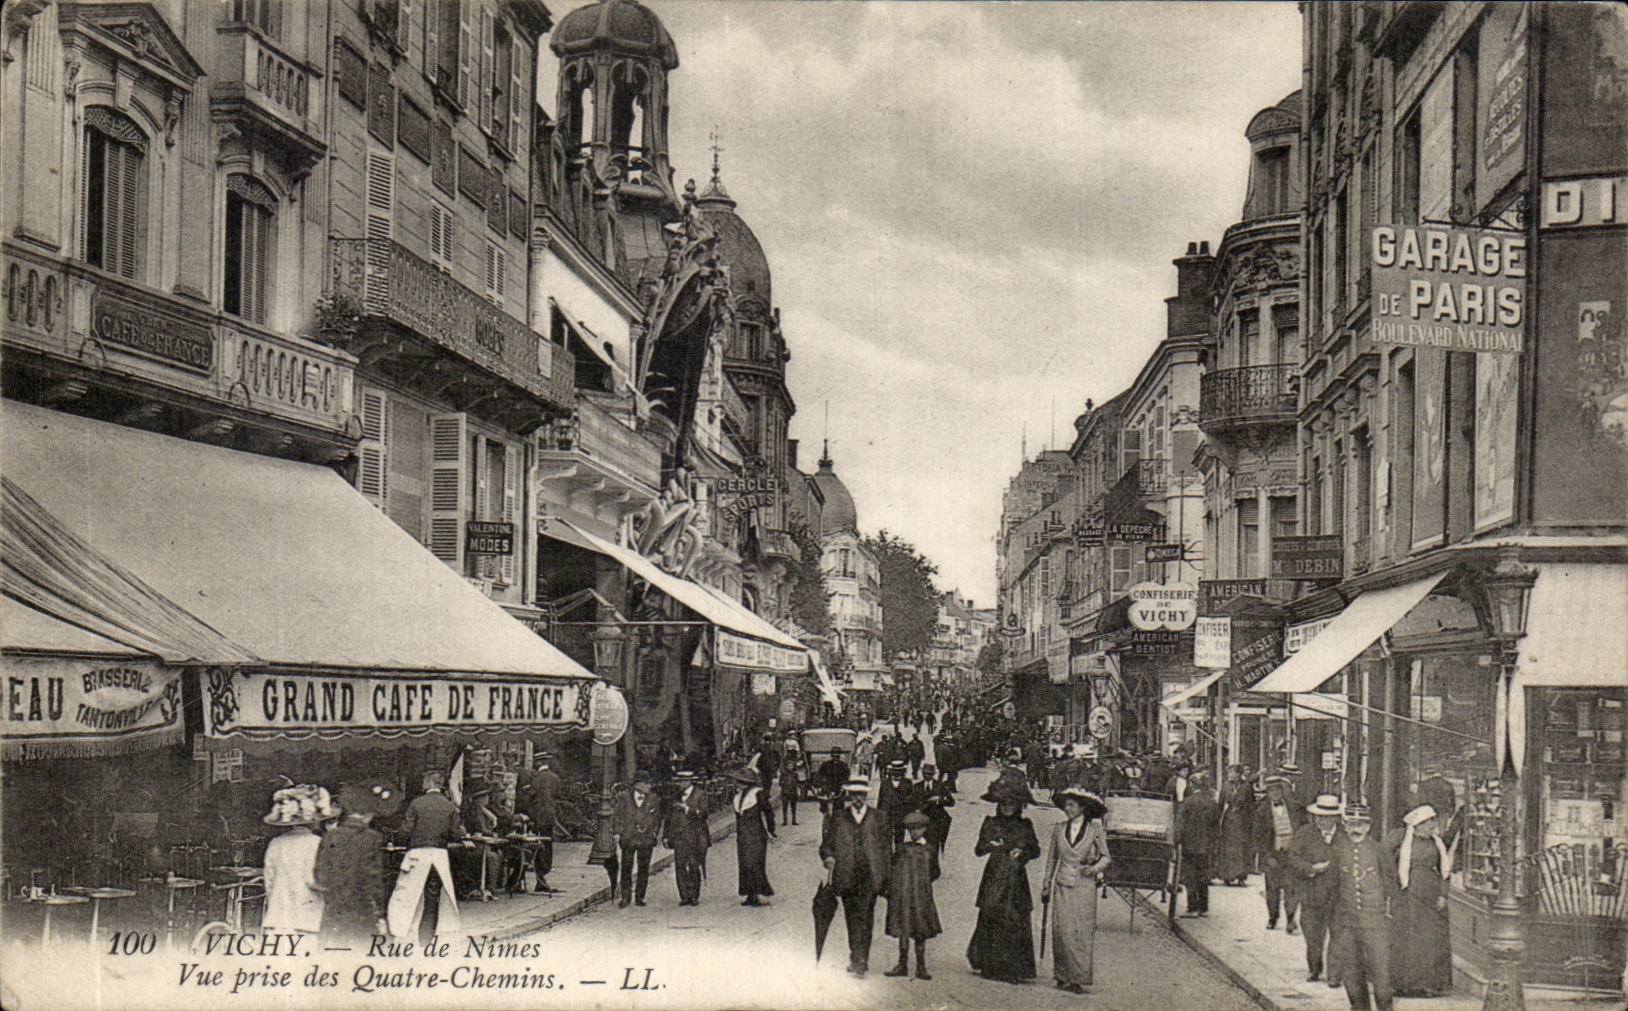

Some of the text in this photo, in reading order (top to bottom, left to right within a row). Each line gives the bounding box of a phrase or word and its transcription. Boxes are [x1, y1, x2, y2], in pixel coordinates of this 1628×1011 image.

[1372, 226, 1526, 279] GARAGE
[1379, 279, 1522, 328] DE PARIS
[1372, 319, 1452, 347] BOULEVARD
[155, 332, 210, 367] FRANCE
[718, 479, 775, 492] CERCLE
[723, 492, 775, 522] SPORTS
[470, 538, 510, 553] MODES
[1295, 557, 1341, 574] DEBIN
[1133, 589, 1195, 600] CONFISERIE
[1210, 581, 1263, 598] AMERICAN
[1139, 609, 1188, 622] VICHY
[1133, 631, 1179, 643] AMERICAN
[1232, 629, 1283, 664] CONFISERIE
[1136, 644, 1175, 654] DENTIST
[0, 676, 64, 721] EAU
[262, 679, 355, 722] GRAND
[372, 684, 433, 722] CAFE
[448, 685, 475, 720] DE
[487, 686, 564, 720] FRANCE
